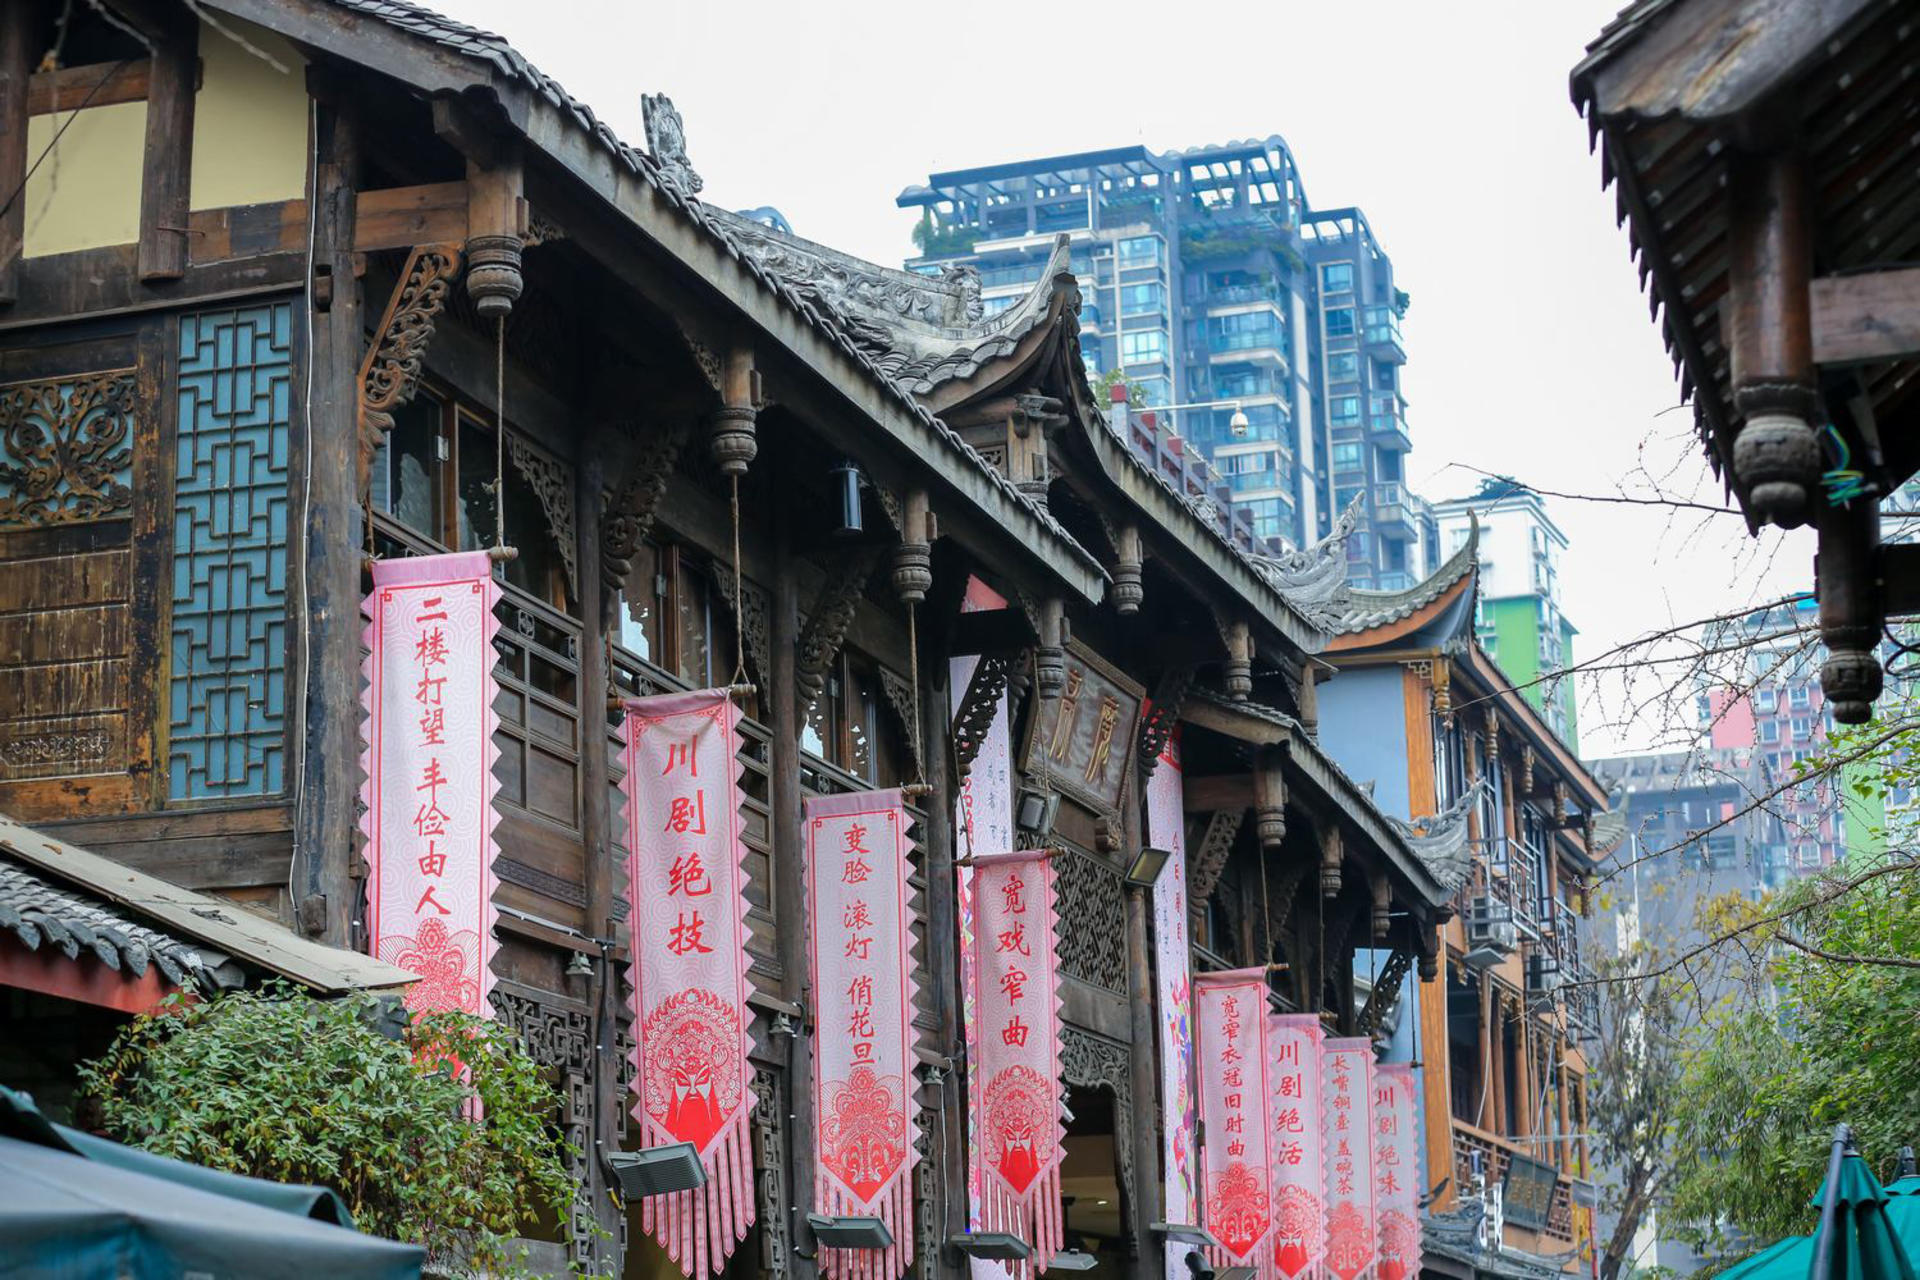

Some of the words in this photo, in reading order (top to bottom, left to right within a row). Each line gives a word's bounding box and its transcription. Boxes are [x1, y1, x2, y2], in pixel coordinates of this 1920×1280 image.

[413, 596, 451, 916] 二楼打望丰俭由人
[662, 734, 714, 954] 川剧绝技
[994, 874, 1031, 1048] 宽戏窄曲
[1220, 994, 1246, 1158] 宽窄衣冠旧时曲
[1274, 1040, 1304, 1166] 川剧绝活
[1375, 1086, 1402, 1196] 川剧绝味
